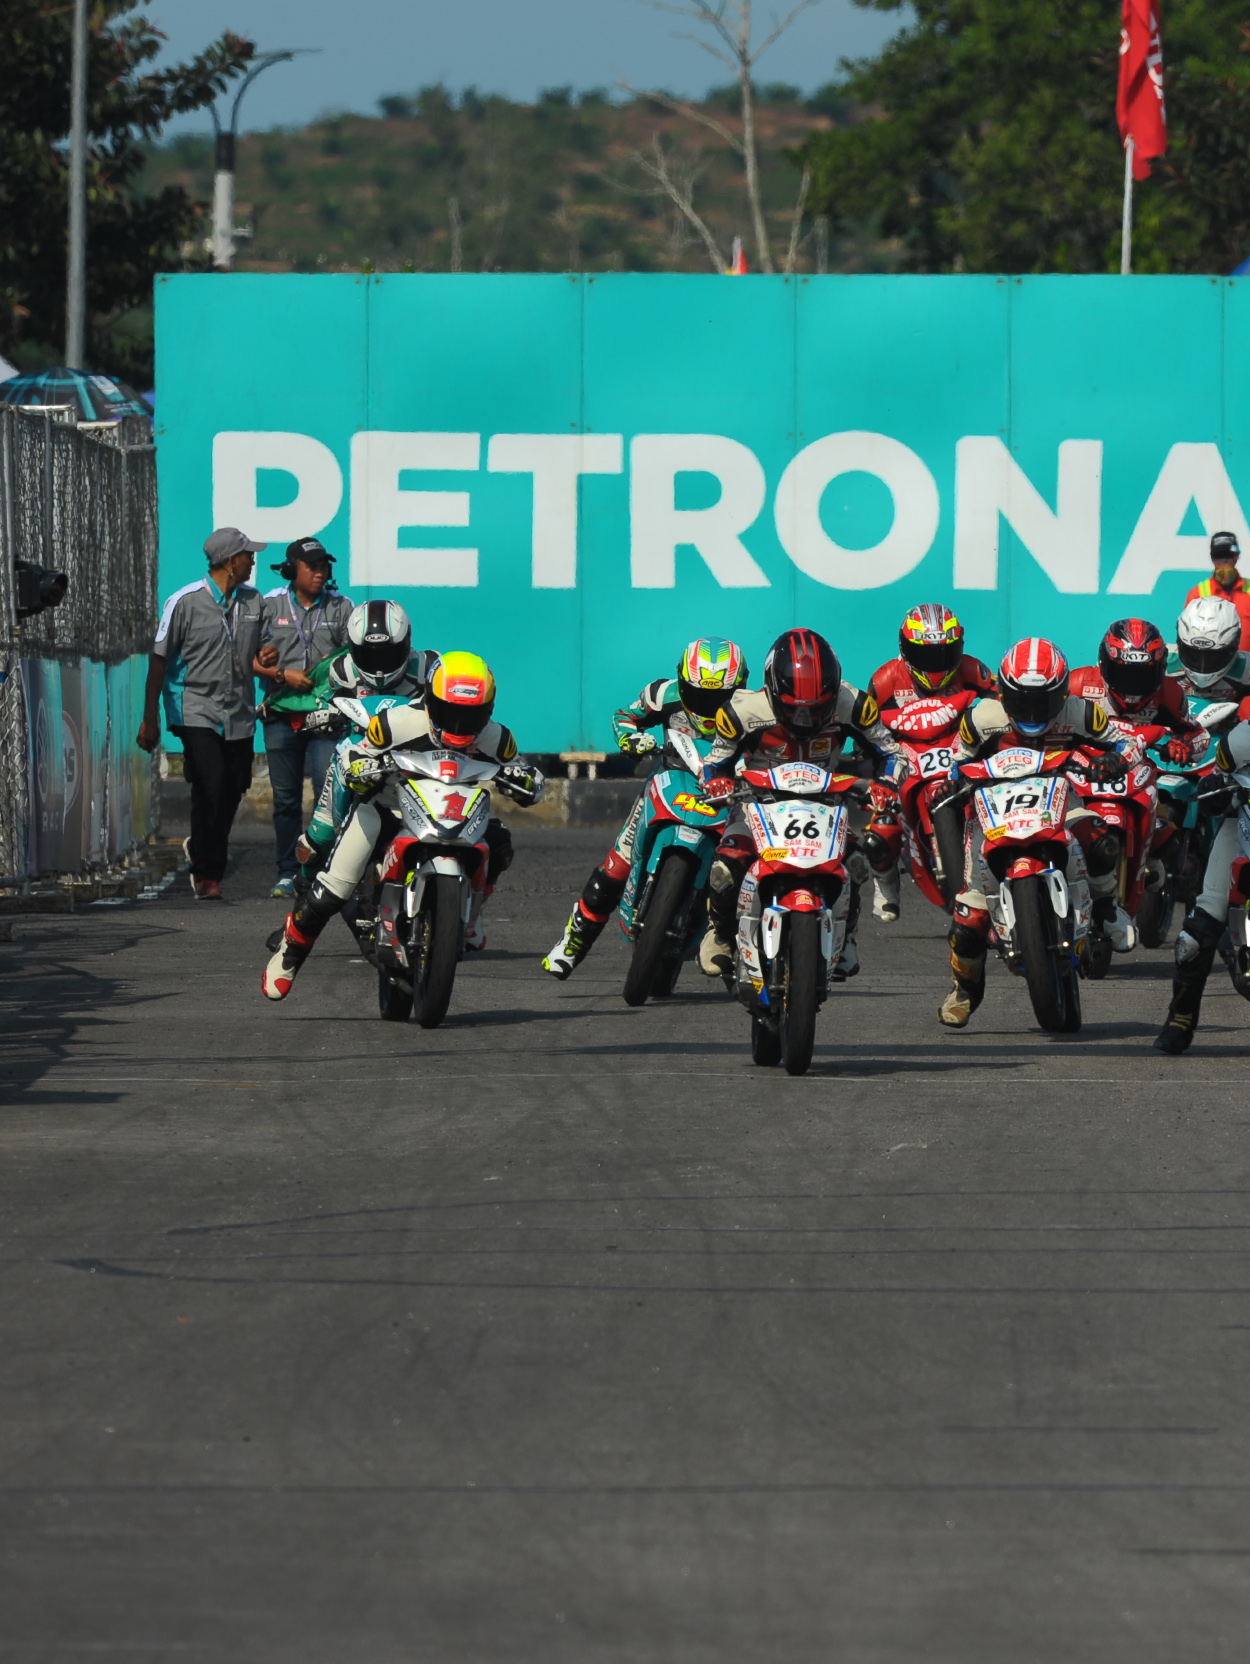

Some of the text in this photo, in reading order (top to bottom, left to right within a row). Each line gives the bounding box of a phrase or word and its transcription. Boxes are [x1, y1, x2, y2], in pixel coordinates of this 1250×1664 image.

[903, 698, 944, 714] MOTUL
[1203, 702, 1230, 719] PETRONAS
[920, 749, 951, 774] 28
[442, 793, 467, 822] 1
[1004, 794, 1039, 814] 19
[784, 819, 820, 840] 66
[805, 840, 823, 849] SAM
